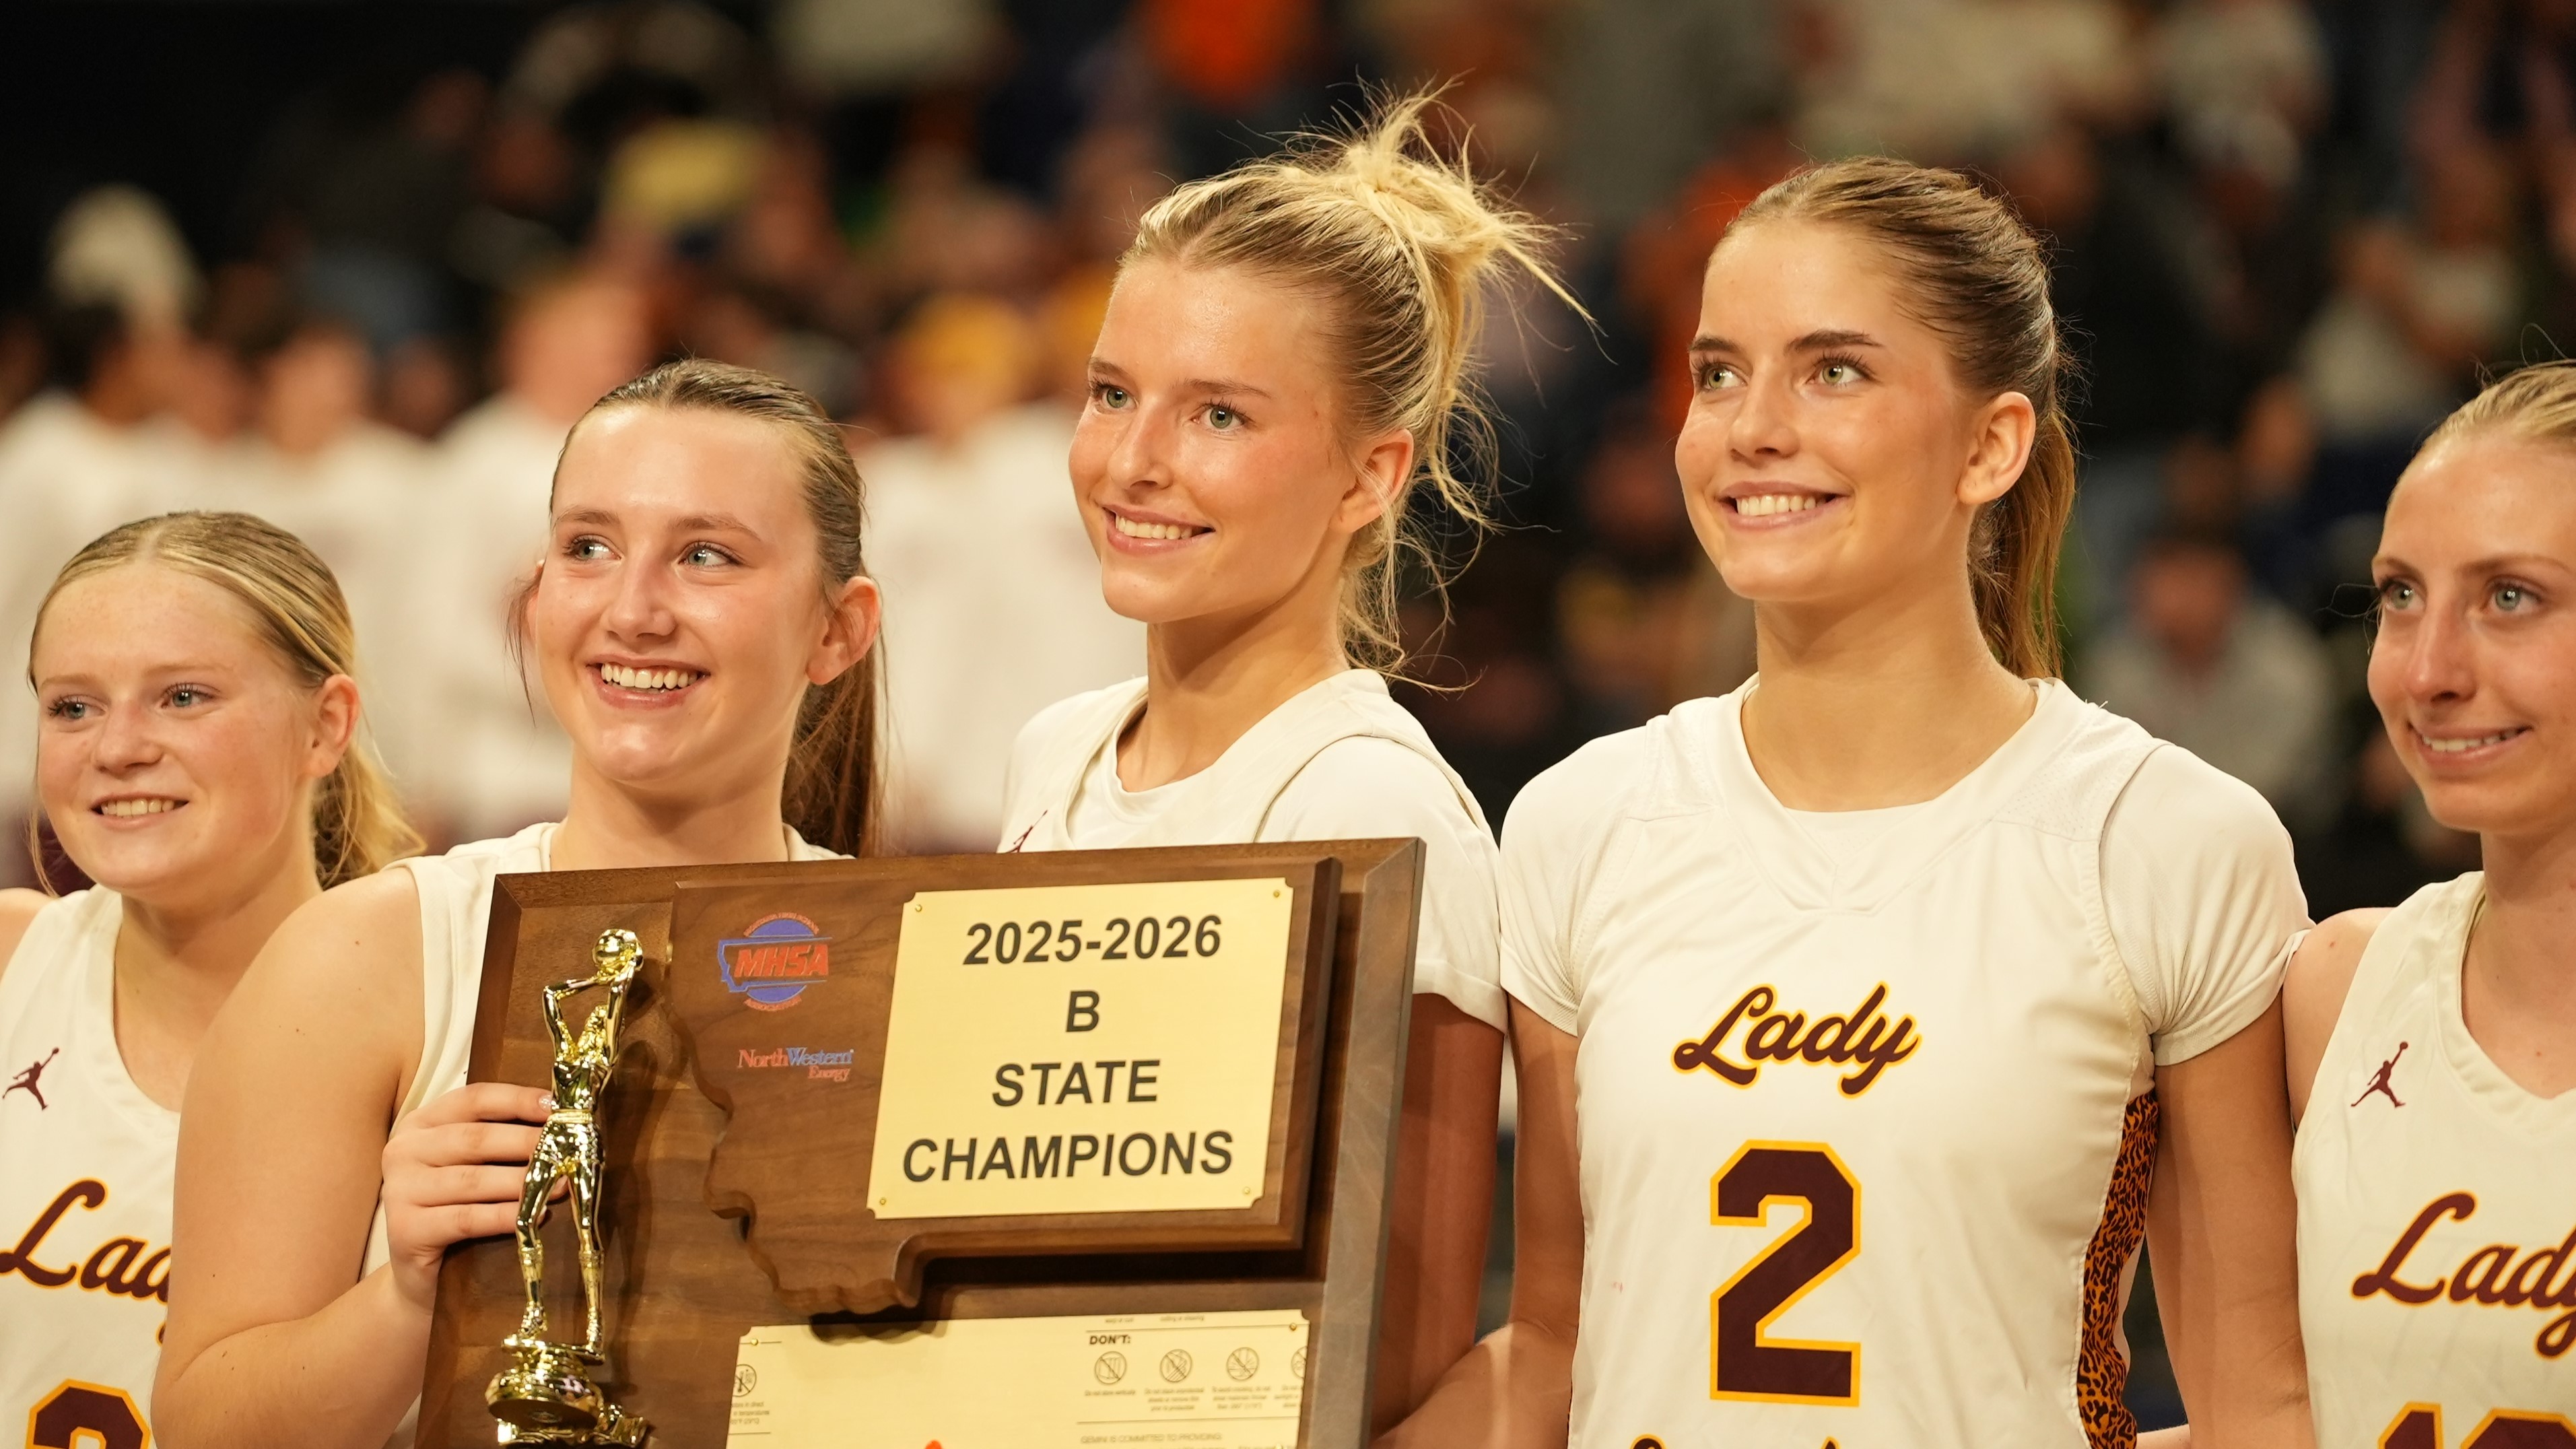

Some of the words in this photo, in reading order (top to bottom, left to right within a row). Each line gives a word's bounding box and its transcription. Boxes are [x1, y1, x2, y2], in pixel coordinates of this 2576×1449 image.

[734, 943, 829, 978] MHSA
[962, 914, 1222, 966] 2025-2026
[1065, 990, 1099, 1034] B
[737, 1047, 852, 1069] NorthWestern
[1670, 980, 1923, 1100] Lady
[808, 1065, 851, 1083] Energy
[991, 1059, 1161, 1108] STATE
[902, 1130, 1233, 1183] CHAMPIONS
[1709, 1139, 1863, 1409] 2
